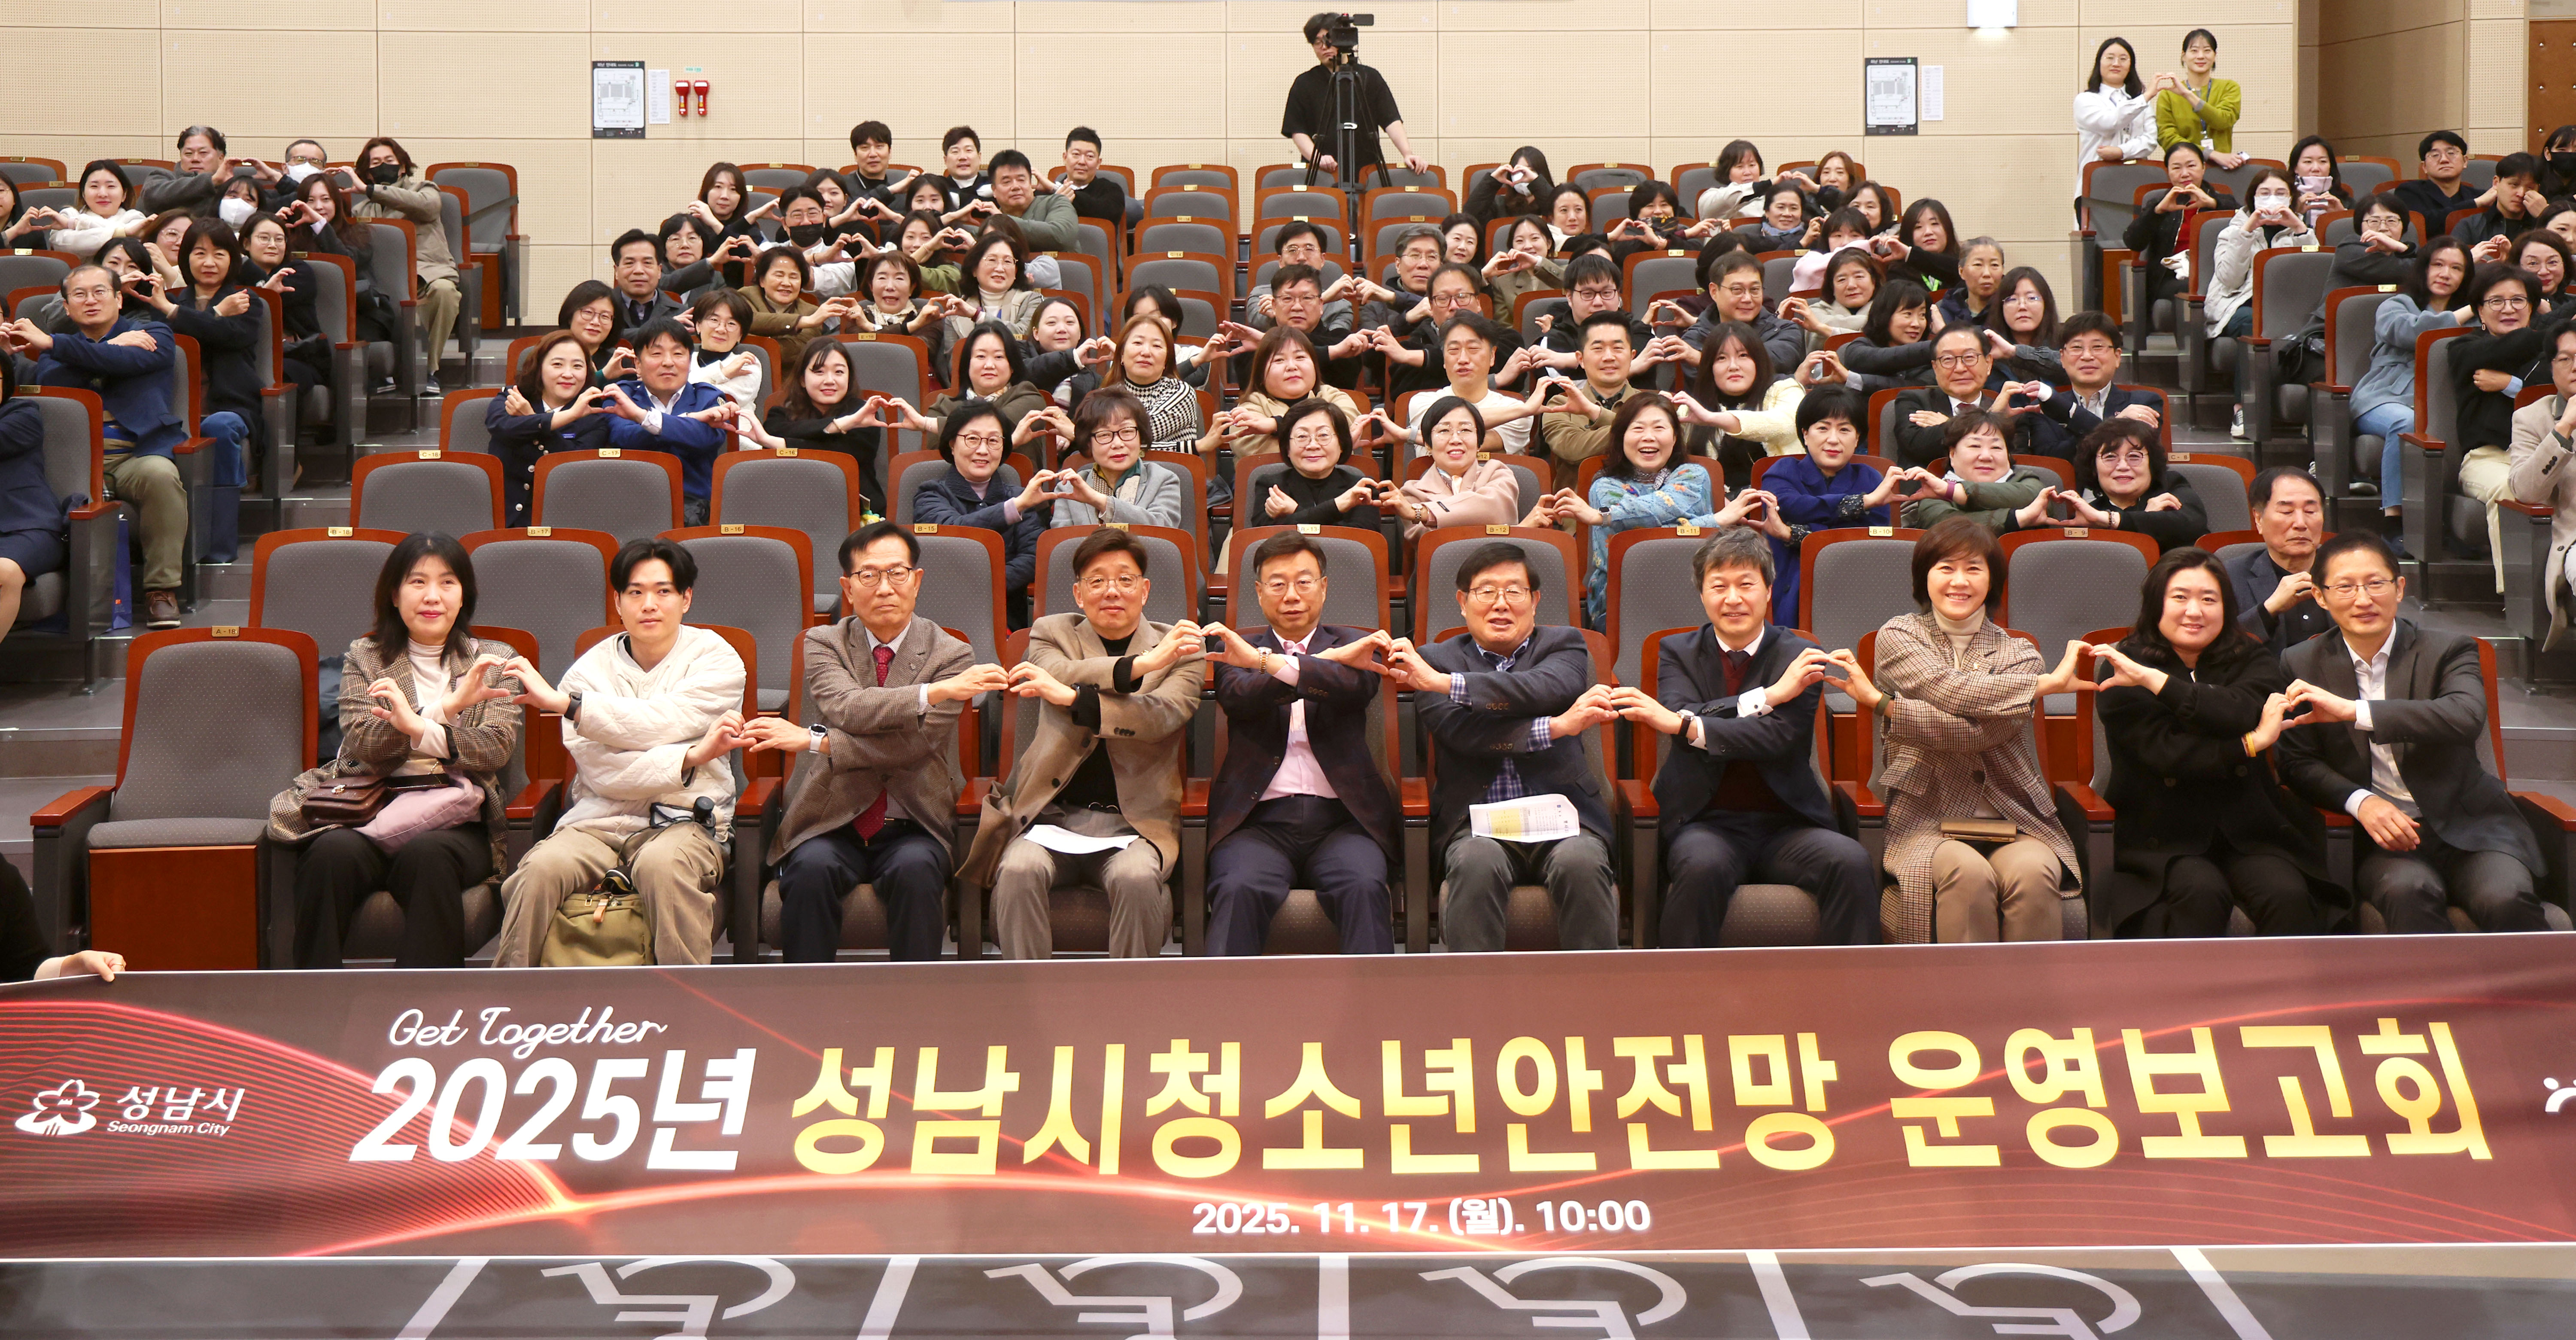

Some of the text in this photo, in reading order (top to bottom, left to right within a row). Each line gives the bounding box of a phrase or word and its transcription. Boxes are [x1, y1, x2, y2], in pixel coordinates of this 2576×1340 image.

[389, 1005, 668, 1060] Get Together
[117, 1086, 245, 1121] 성남시
[349, 1017, 2493, 1177] 2025년 성남시청소년안전망 운영보고회
[107, 1120, 230, 1136] Seongnam City
[1192, 1197, 1651, 1237] 2025. 11. 17. (월). 10:00
